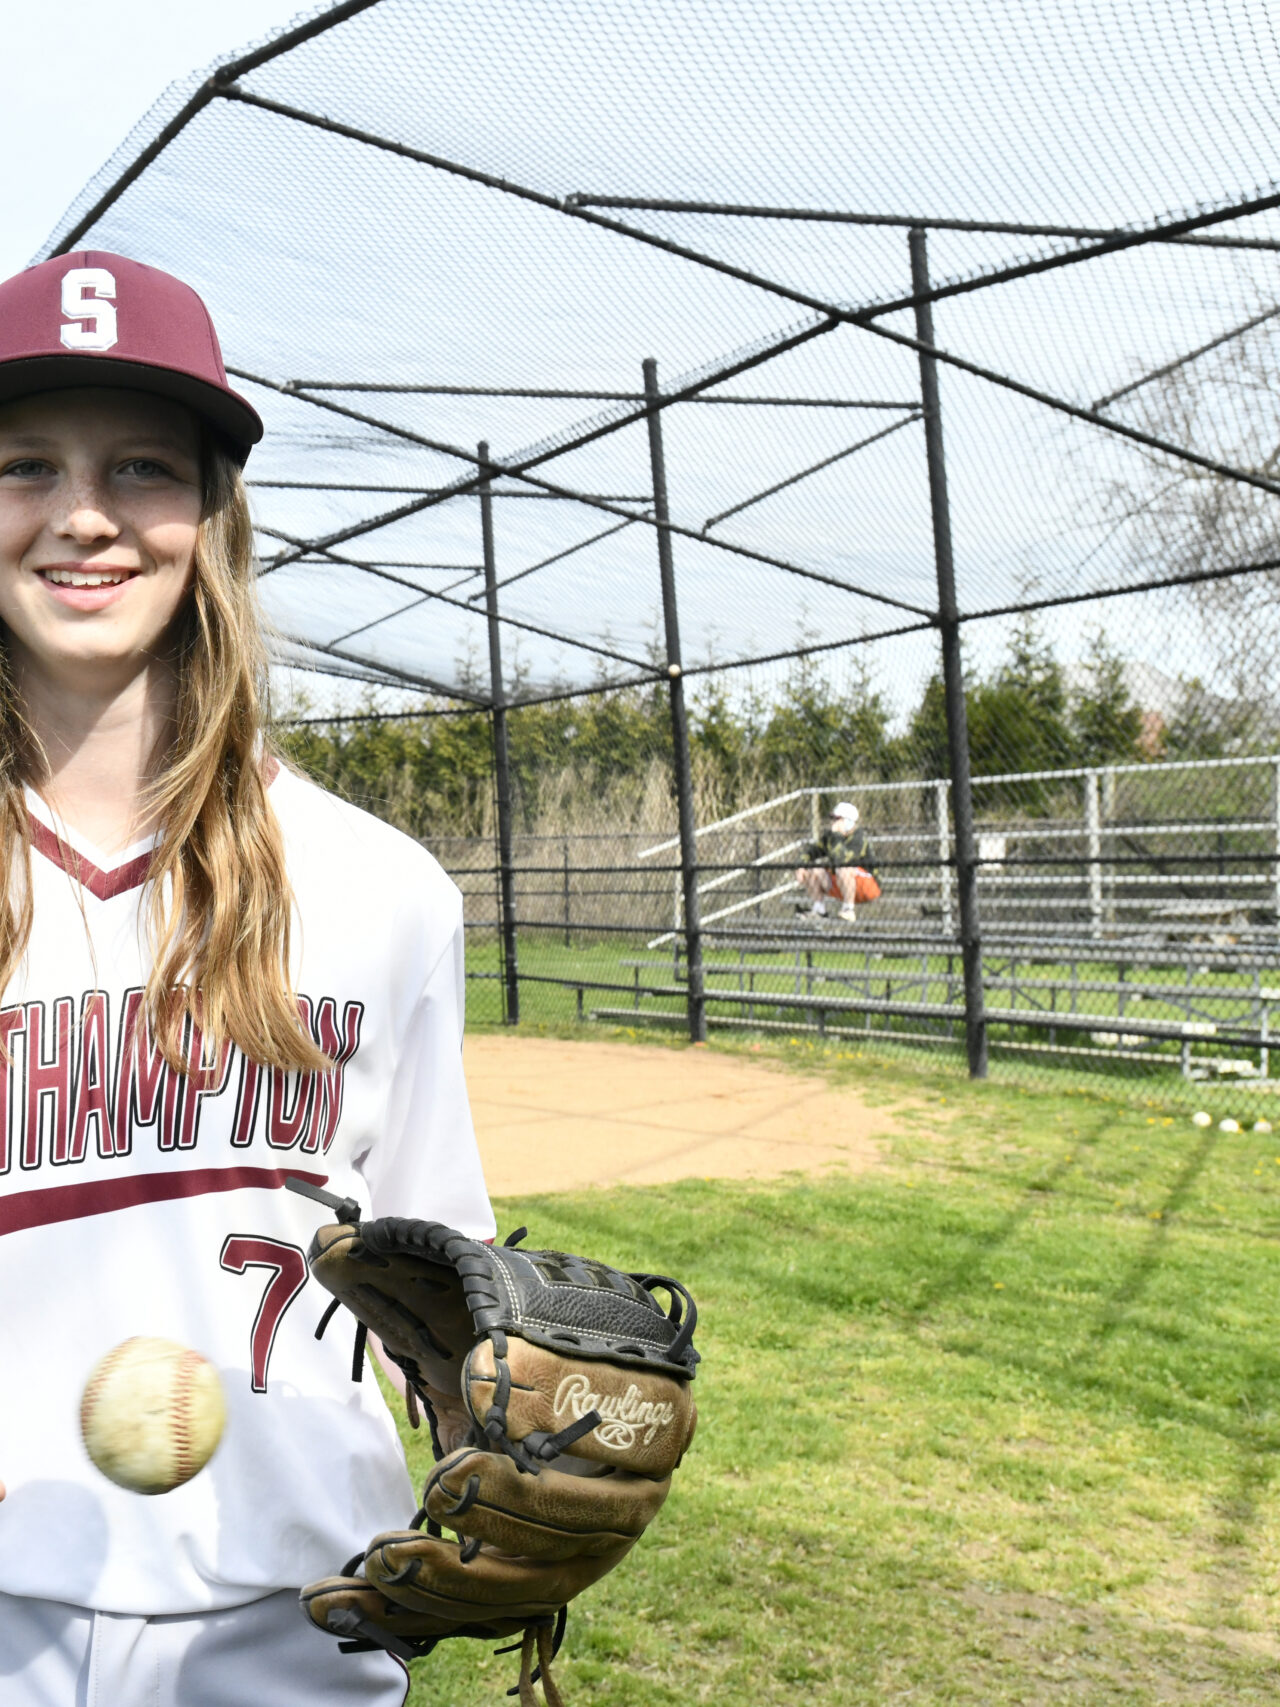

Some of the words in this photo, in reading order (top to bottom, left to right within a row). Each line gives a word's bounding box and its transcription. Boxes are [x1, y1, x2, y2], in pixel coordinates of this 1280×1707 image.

[60, 268, 118, 351] S
[219, 1234, 310, 1394] 7
[553, 1374, 675, 1445] Rawlings
